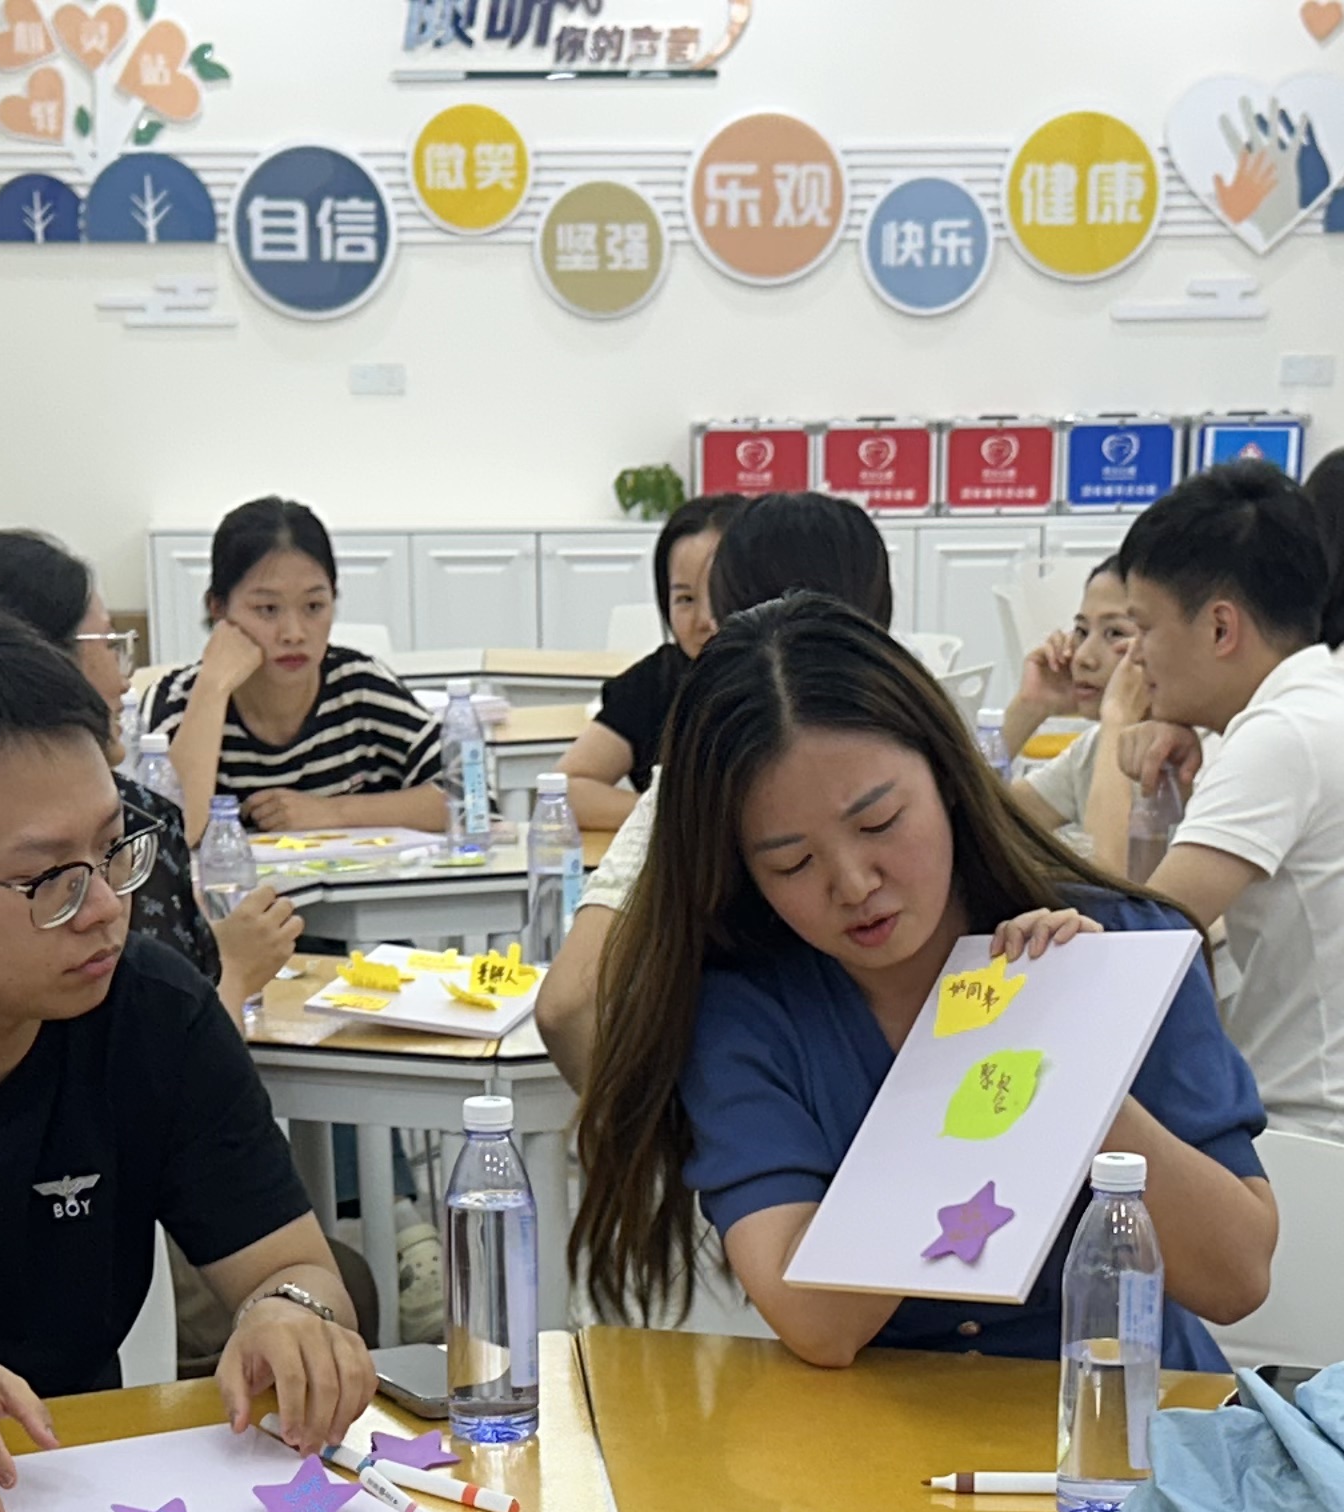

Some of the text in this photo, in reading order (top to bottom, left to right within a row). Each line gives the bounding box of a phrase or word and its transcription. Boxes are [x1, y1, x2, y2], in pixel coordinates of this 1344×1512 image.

[556, 25, 701, 65] 你的声音
[423, 143, 518, 191] 微笑
[702, 162, 832, 229] 乐观
[1020, 161, 1146, 227] 健康
[247, 197, 380, 262] 自信
[556, 223, 649, 272] 坚强
[880, 219, 974, 268] 快乐
[53, 1199, 91, 1218] BOY
